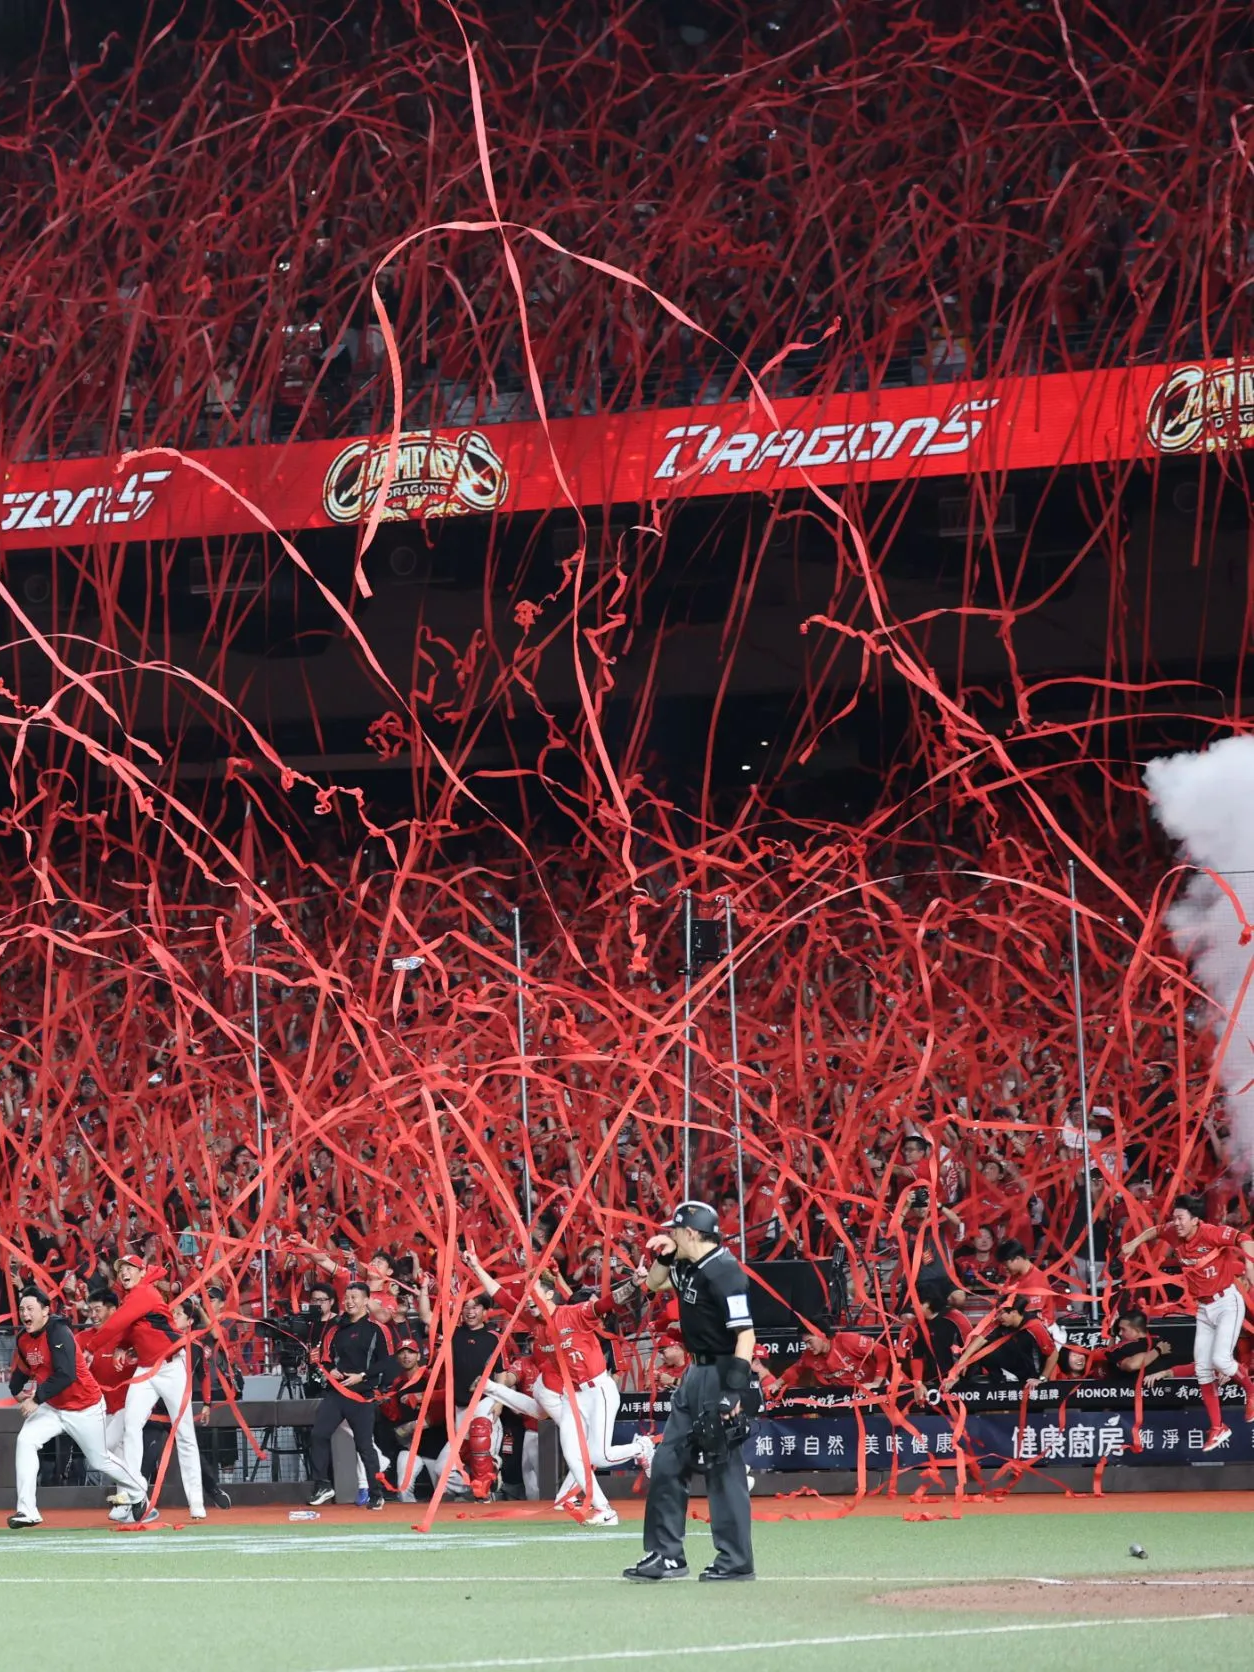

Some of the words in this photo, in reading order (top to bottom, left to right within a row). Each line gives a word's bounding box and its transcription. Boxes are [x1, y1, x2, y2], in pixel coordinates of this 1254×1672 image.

[654, 399, 1000, 479] DRAGONS
[945, 1391, 980, 1401] ONOR
[1076, 1387, 1118, 1398] HONOR
[1120, 1386, 1148, 1399] Maic
[755, 1434, 845, 1457] 純淨自然
[864, 1432, 954, 1456] 美味健康
[1011, 1423, 1125, 1459] 健康廚房
[1139, 1427, 1230, 1449] 純淨自
